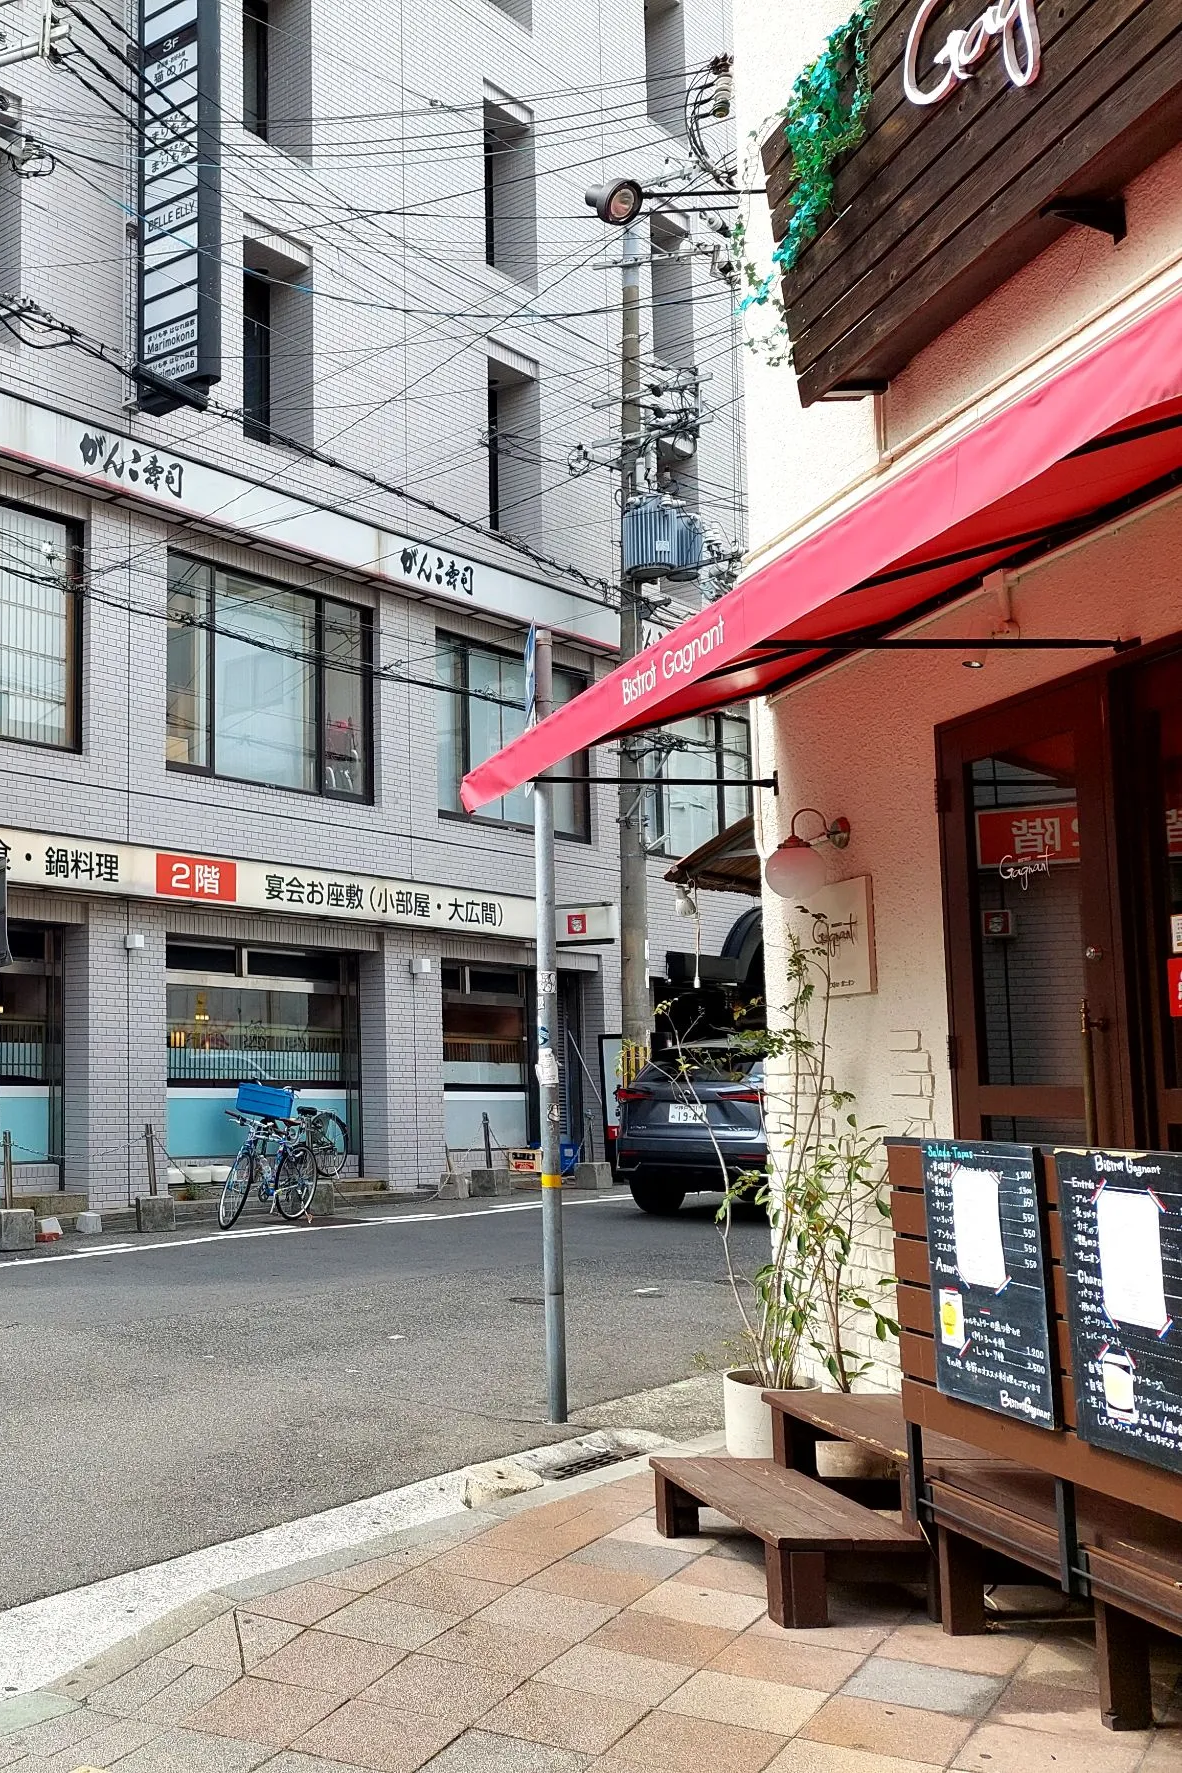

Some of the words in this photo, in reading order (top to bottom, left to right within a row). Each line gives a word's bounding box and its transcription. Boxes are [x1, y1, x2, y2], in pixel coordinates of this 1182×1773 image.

[162, 36, 180, 53] 3F
[153, 58, 189, 85] 猫の介
[148, 210, 174, 232] BELLE
[175, 200, 195, 220] ELLY
[147, 328, 195, 354] Marimokona
[159, 359, 195, 378] imokona
[621, 660, 657, 705] Bistrot
[661, 614, 725, 679] Gagnant
[170, 861, 221, 897] 2階
[999, 845, 1056, 891] Gagnant
[264, 872, 505, 929] 宴会お座敷（小部屋・大広間）
[1094, 1154, 1125, 1173] Bistrot
[1125, 1156, 1162, 1177] Gagnant
[1022, 1212, 1035, 1223] 550
[1023, 1229, 1036, 1239] 550
[1023, 1244, 1037, 1254] 550
[1024, 1259, 1038, 1269] 550
[1083, 1316, 1121, 1332] ポークリエト
